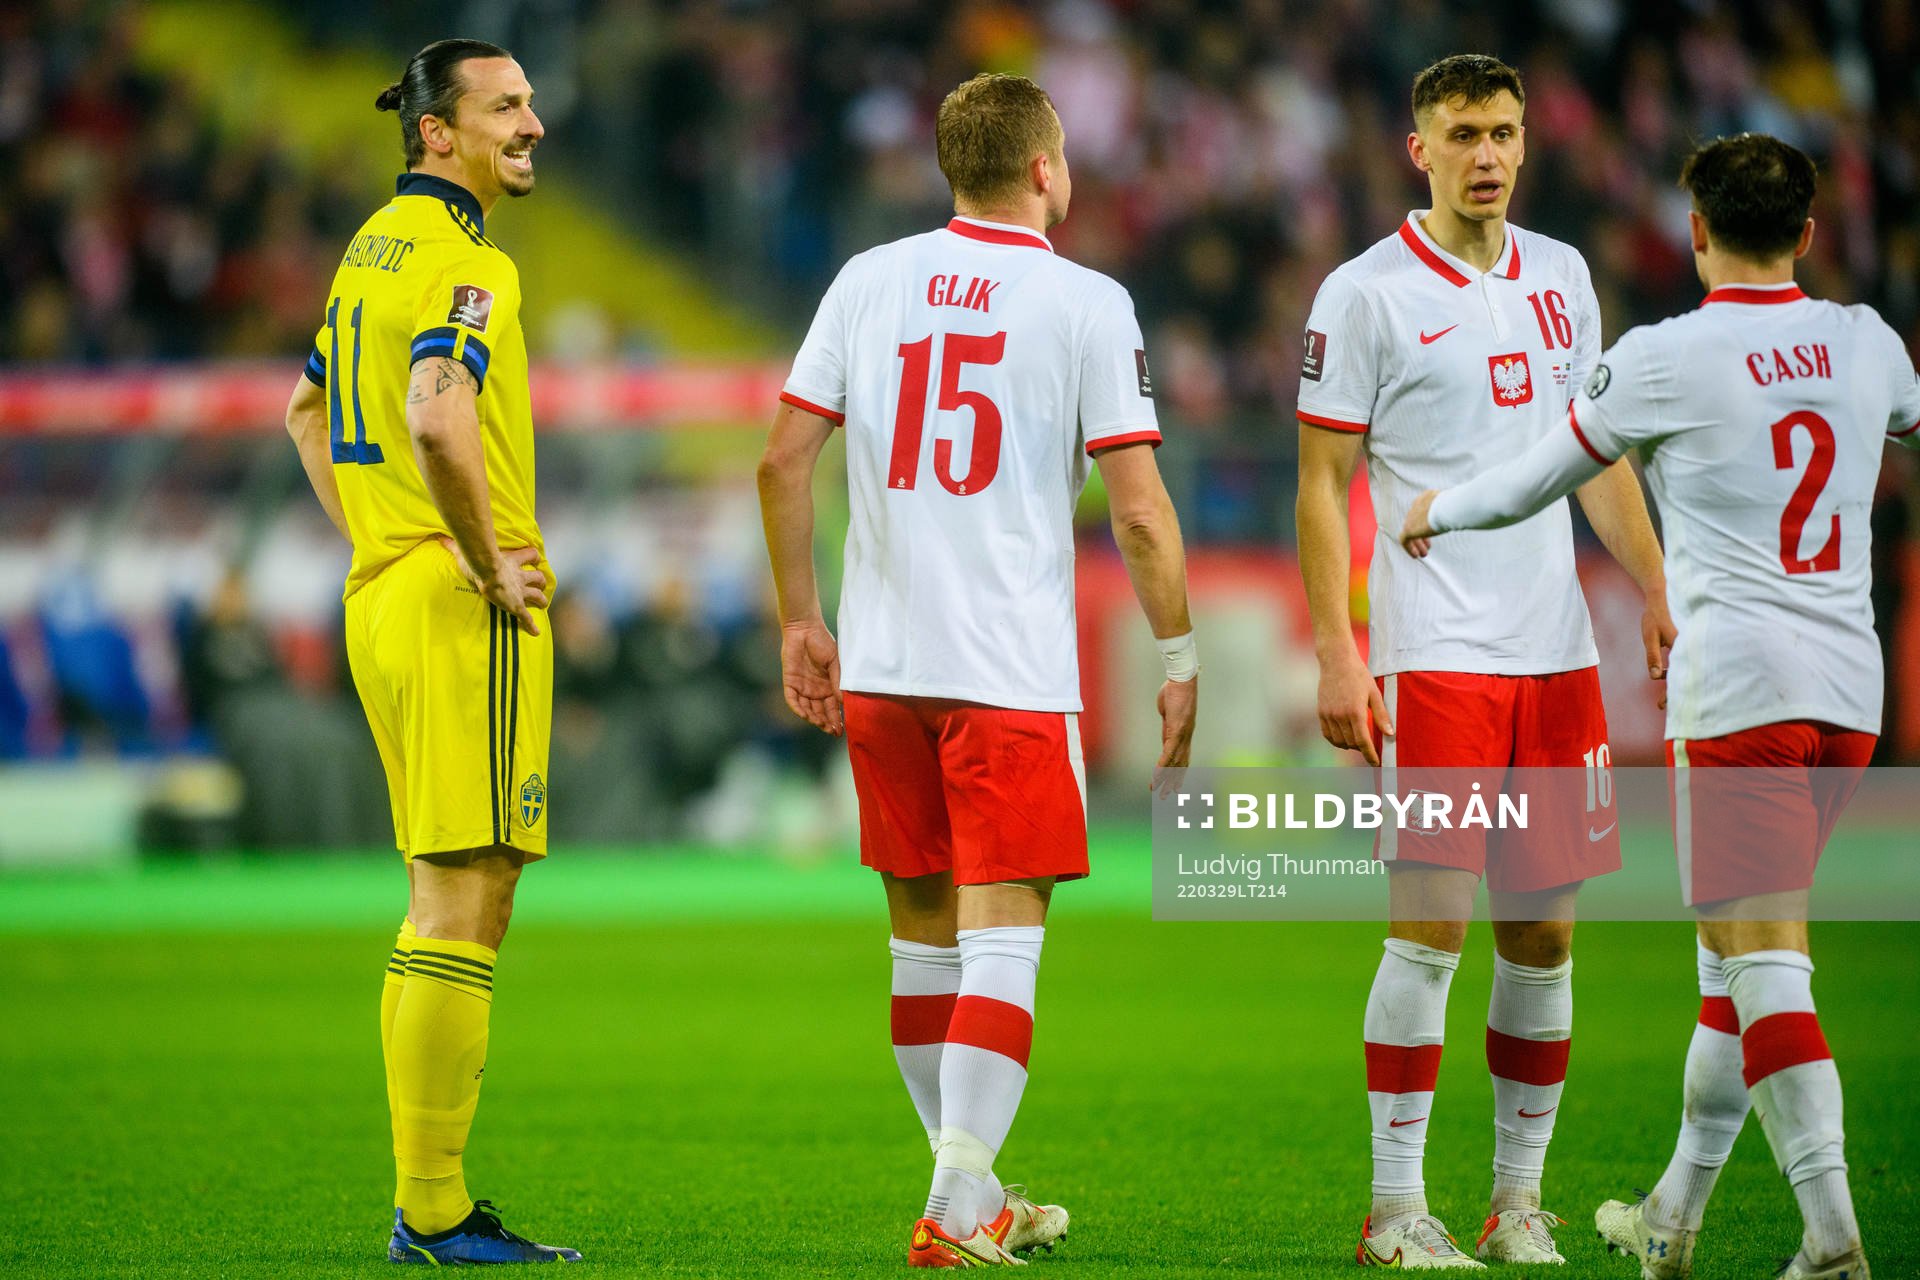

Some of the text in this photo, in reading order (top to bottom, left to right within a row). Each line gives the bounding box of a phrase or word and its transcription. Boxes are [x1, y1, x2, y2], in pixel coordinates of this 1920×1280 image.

[341, 235, 417, 273] AHIMOVIĆ
[927, 274, 1001, 313] GLIK
[1526, 289, 1573, 350] 16
[327, 296, 385, 465] 11
[1746, 344, 1832, 386] CASH
[887, 330, 1007, 496] 15
[1770, 410, 1841, 576] 2
[1583, 743, 1612, 812] 16
